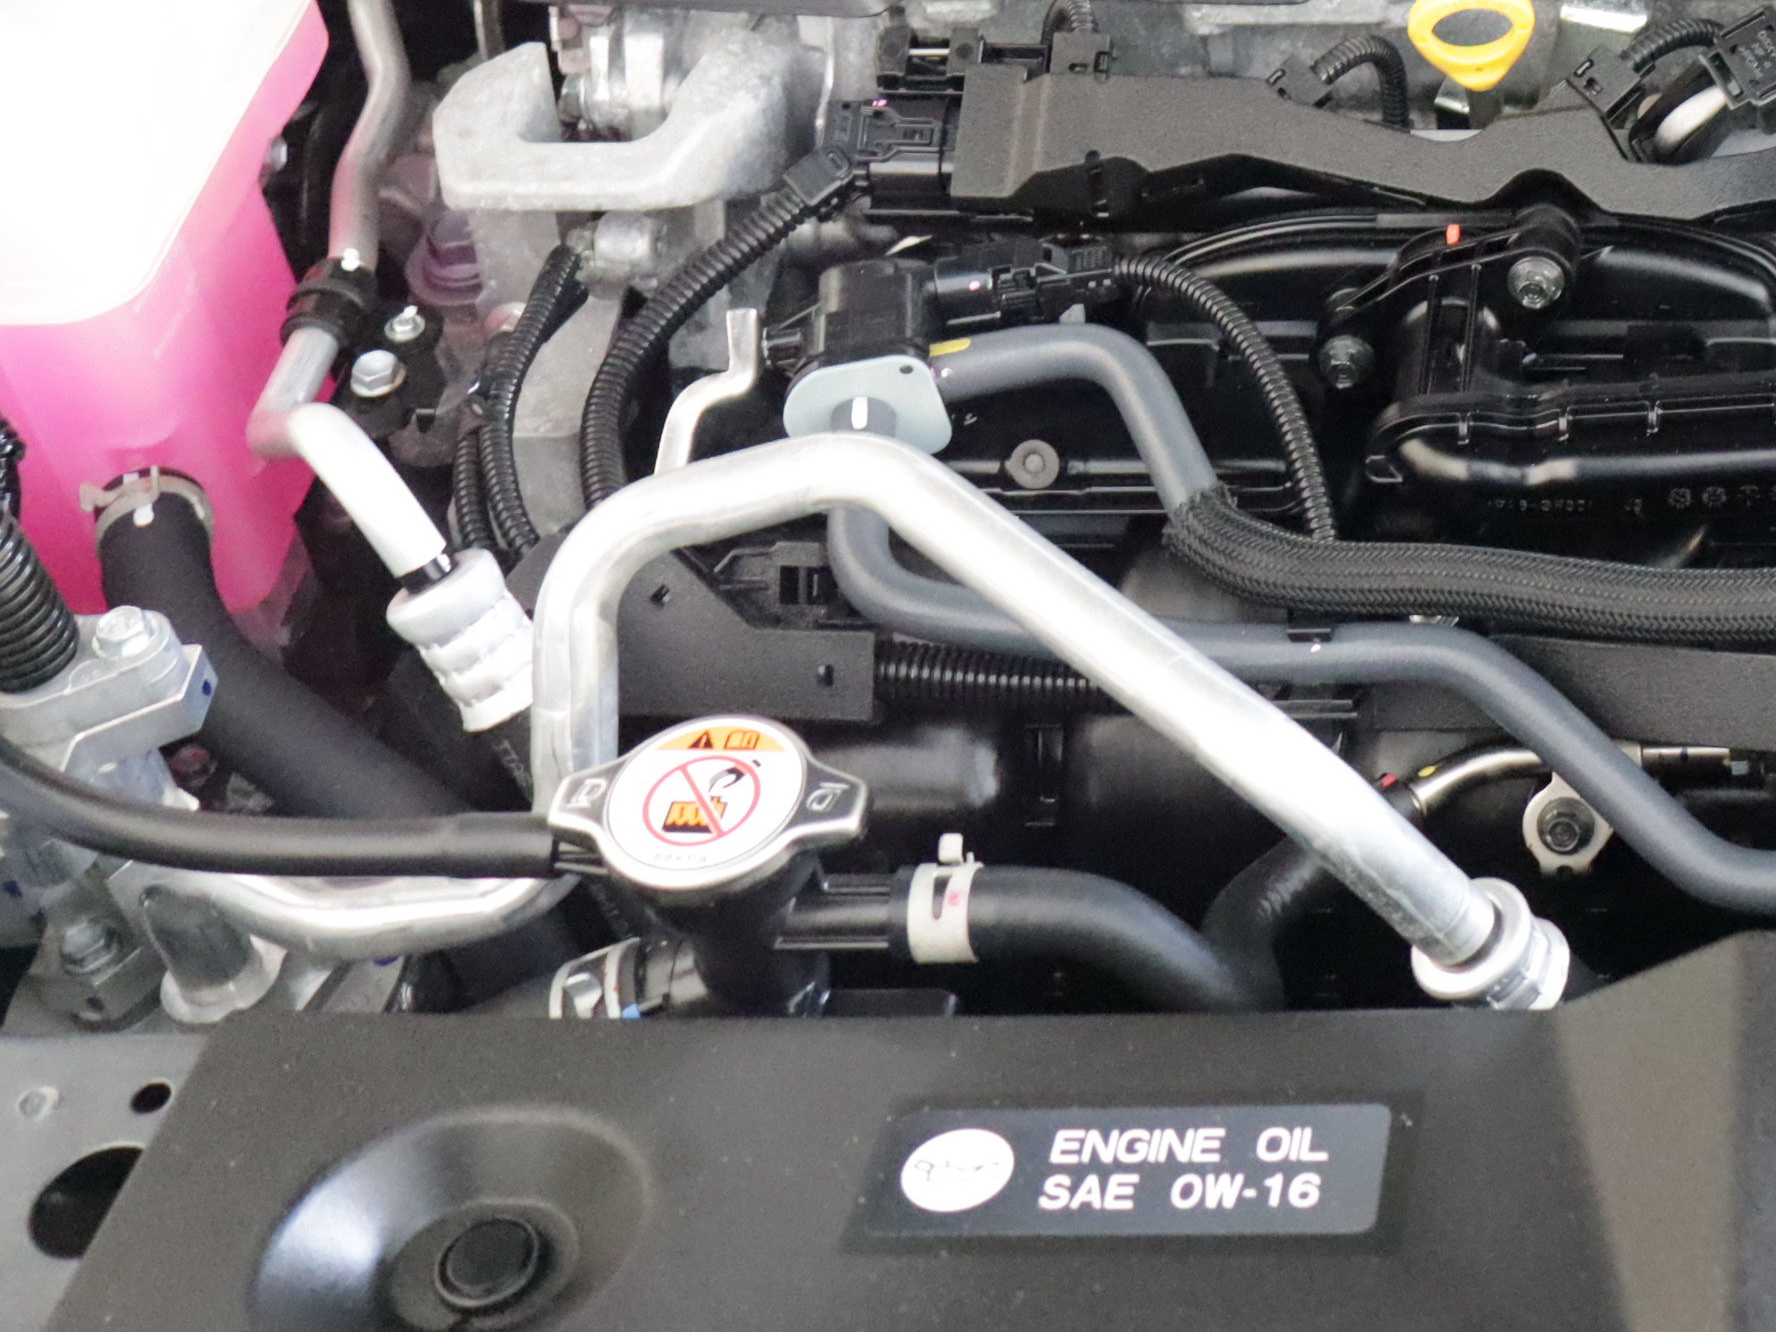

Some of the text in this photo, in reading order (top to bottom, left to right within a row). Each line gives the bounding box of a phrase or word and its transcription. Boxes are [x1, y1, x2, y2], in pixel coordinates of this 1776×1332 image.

[1048, 1126, 1330, 1165] ENGINE OIL
[1037, 1171, 1323, 1211] SAE 0W-16
